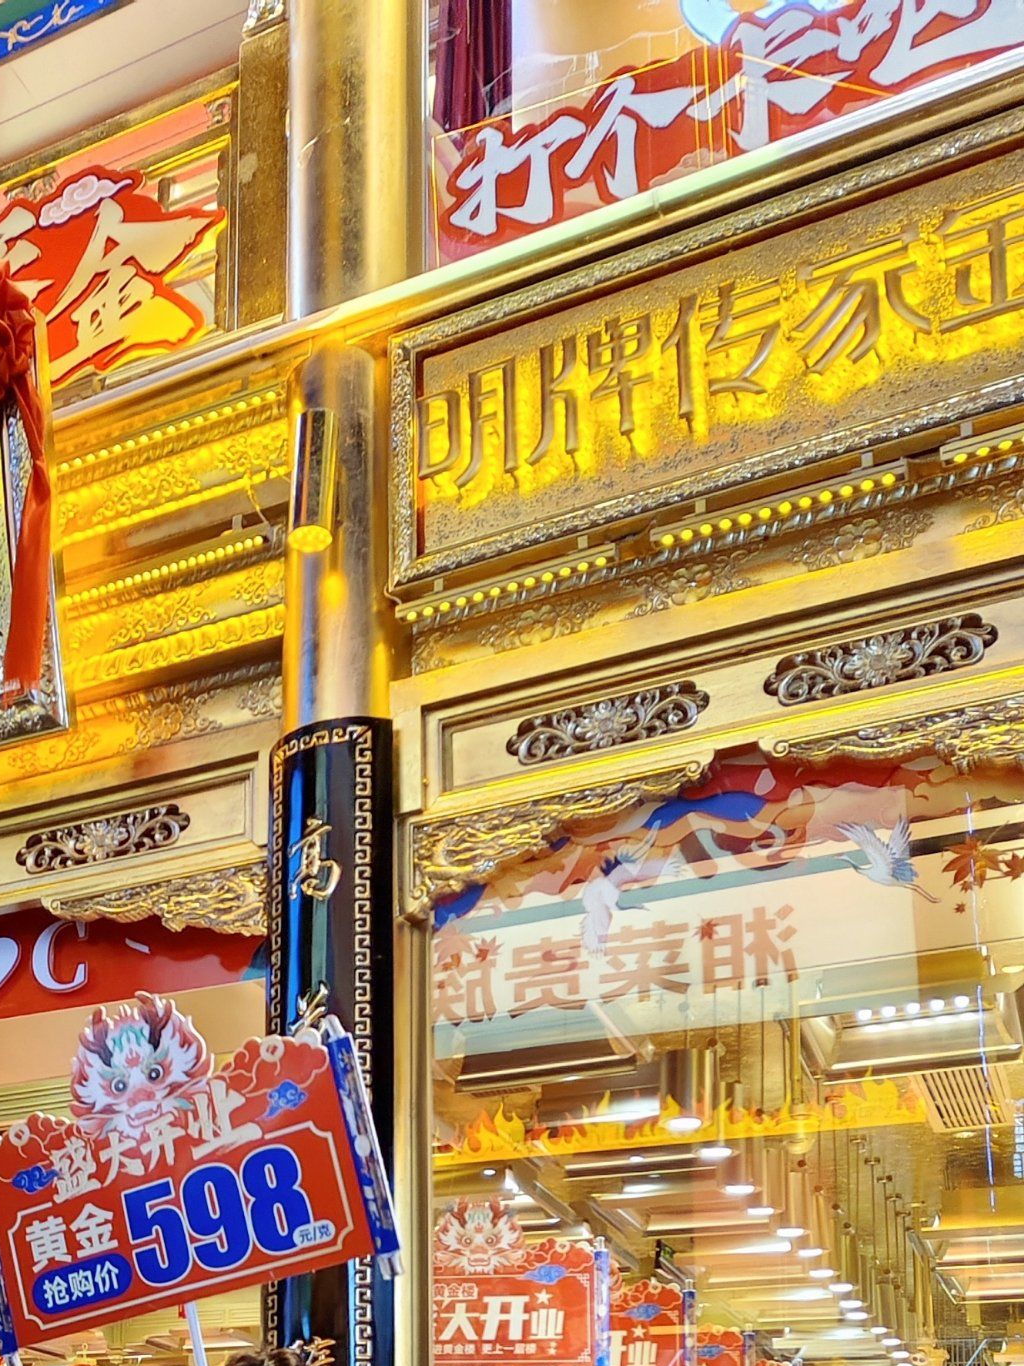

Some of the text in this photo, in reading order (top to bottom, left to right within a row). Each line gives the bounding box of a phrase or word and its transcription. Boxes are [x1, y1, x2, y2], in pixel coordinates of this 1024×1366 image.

[49, 1079, 263, 1205] 盛大开业
[25, 1143, 315, 1286] 黄金 598
[43, 1224, 332, 1308] 抢购价 元/克
[433, 1295, 565, 1341] 大开业
